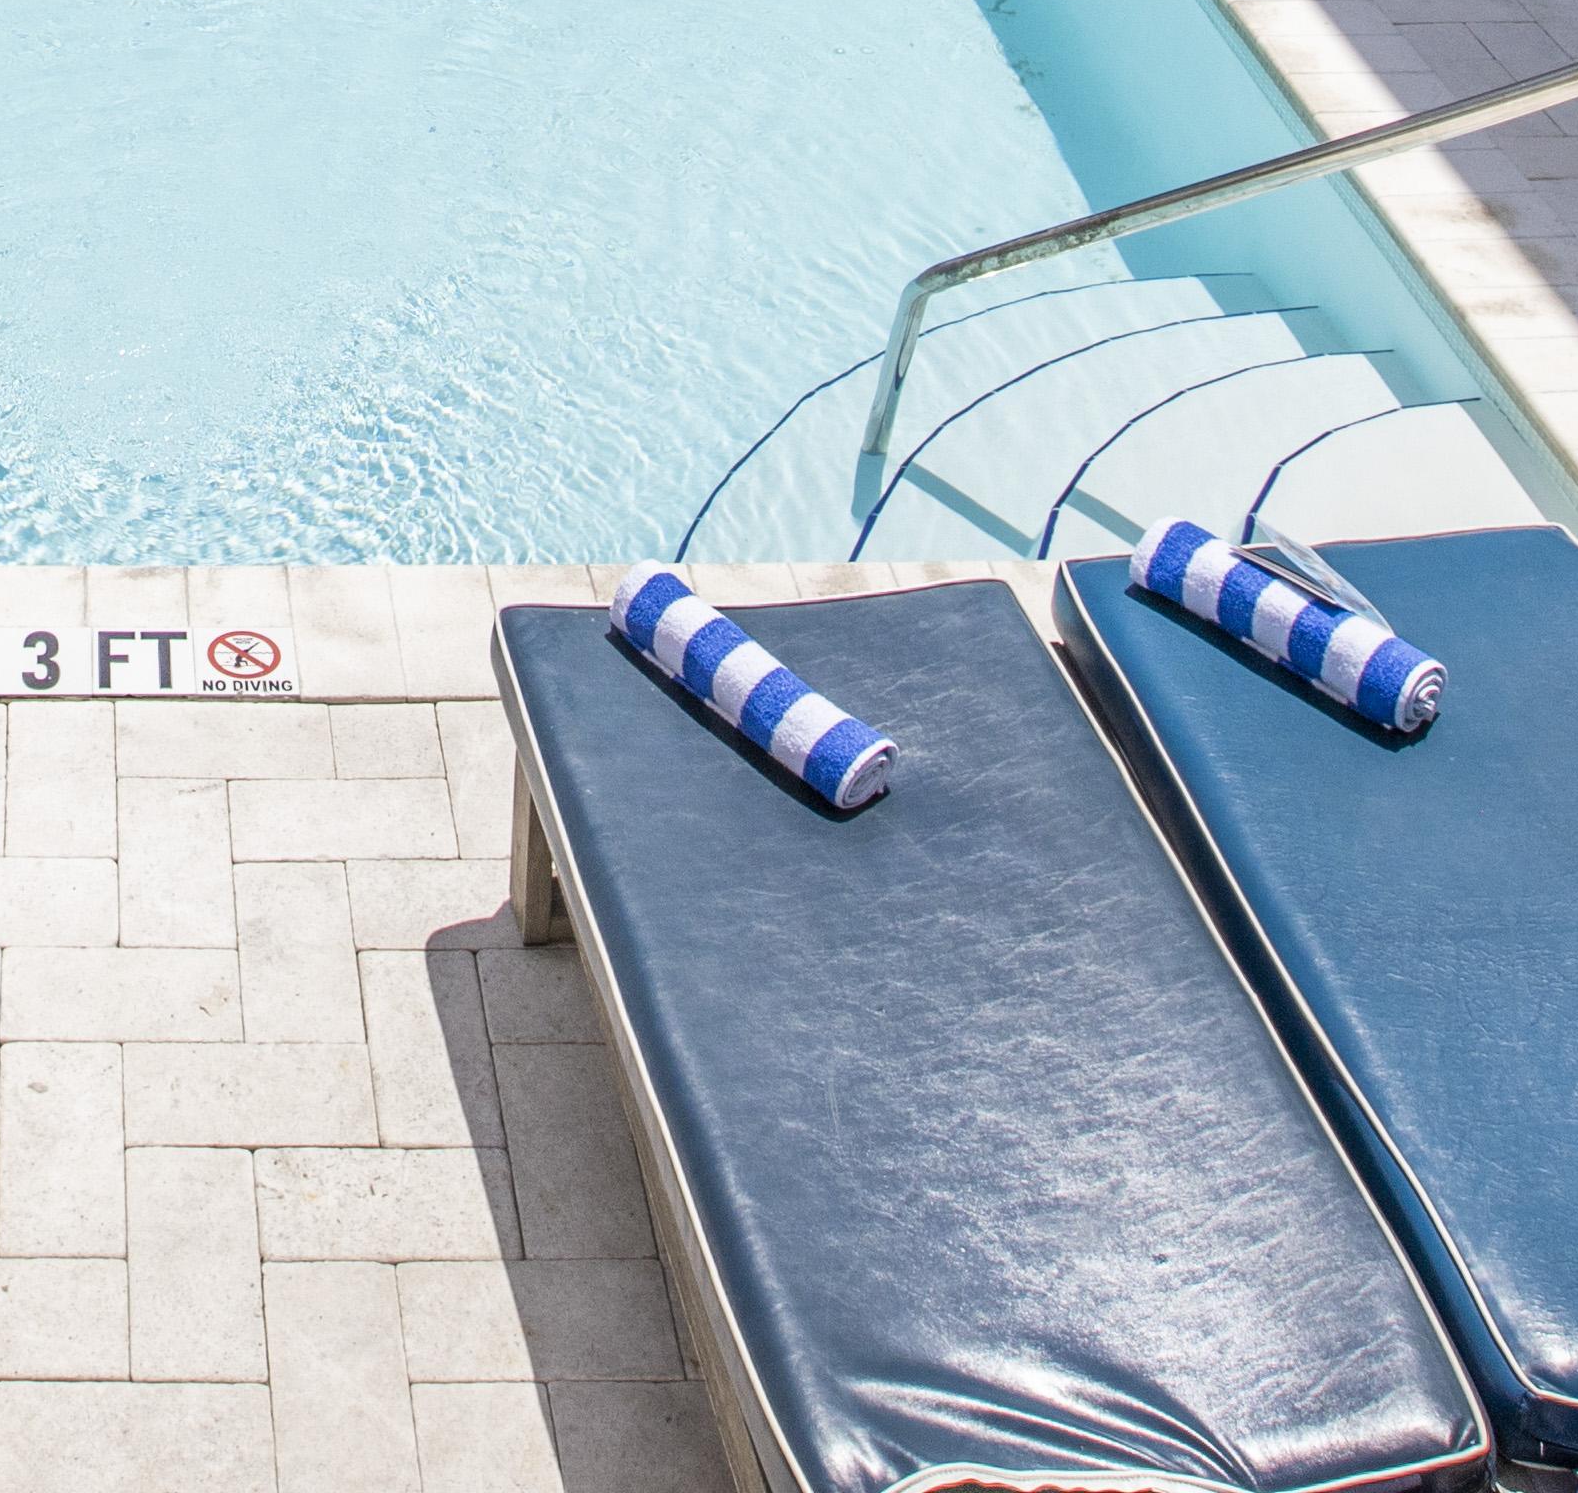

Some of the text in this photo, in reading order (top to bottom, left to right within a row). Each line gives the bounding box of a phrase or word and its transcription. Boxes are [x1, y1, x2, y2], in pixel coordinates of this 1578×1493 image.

[22, 631, 188, 690] 3 FT
[202, 680, 293, 692] NO DIVING
